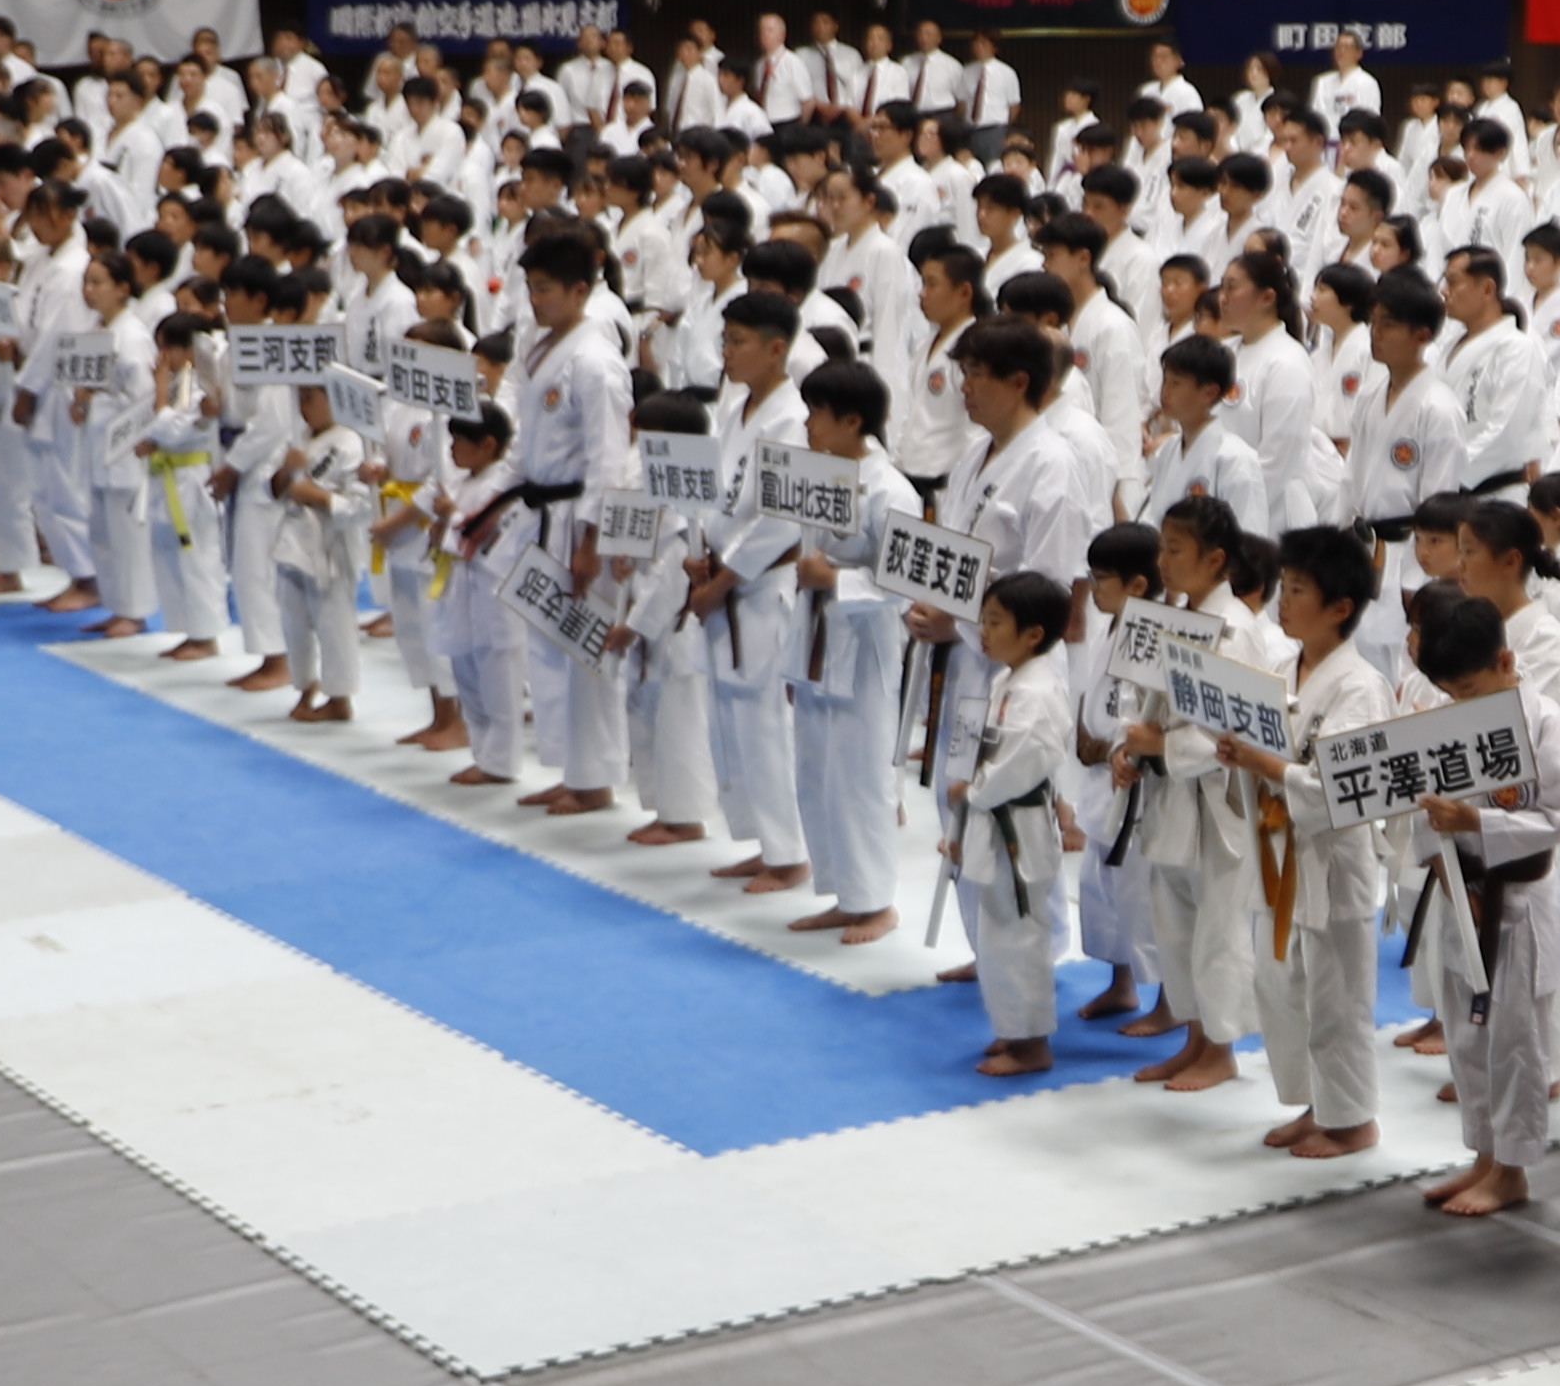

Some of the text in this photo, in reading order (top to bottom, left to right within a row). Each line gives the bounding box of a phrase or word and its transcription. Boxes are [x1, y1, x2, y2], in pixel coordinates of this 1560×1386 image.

[1275, 22, 1408, 51] 町田支部
[238, 334, 339, 375] 三河支部
[391, 363, 475, 414] 町田支部
[648, 464, 718, 503] 針原支部
[759, 469, 853, 528] 富山北支部
[883, 526, 981, 604] 荻窪支部
[1170, 668, 1287, 753] 静岡支部
[1328, 730, 1391, 763] 北海道
[1332, 727, 1523, 818] 平澤道場
